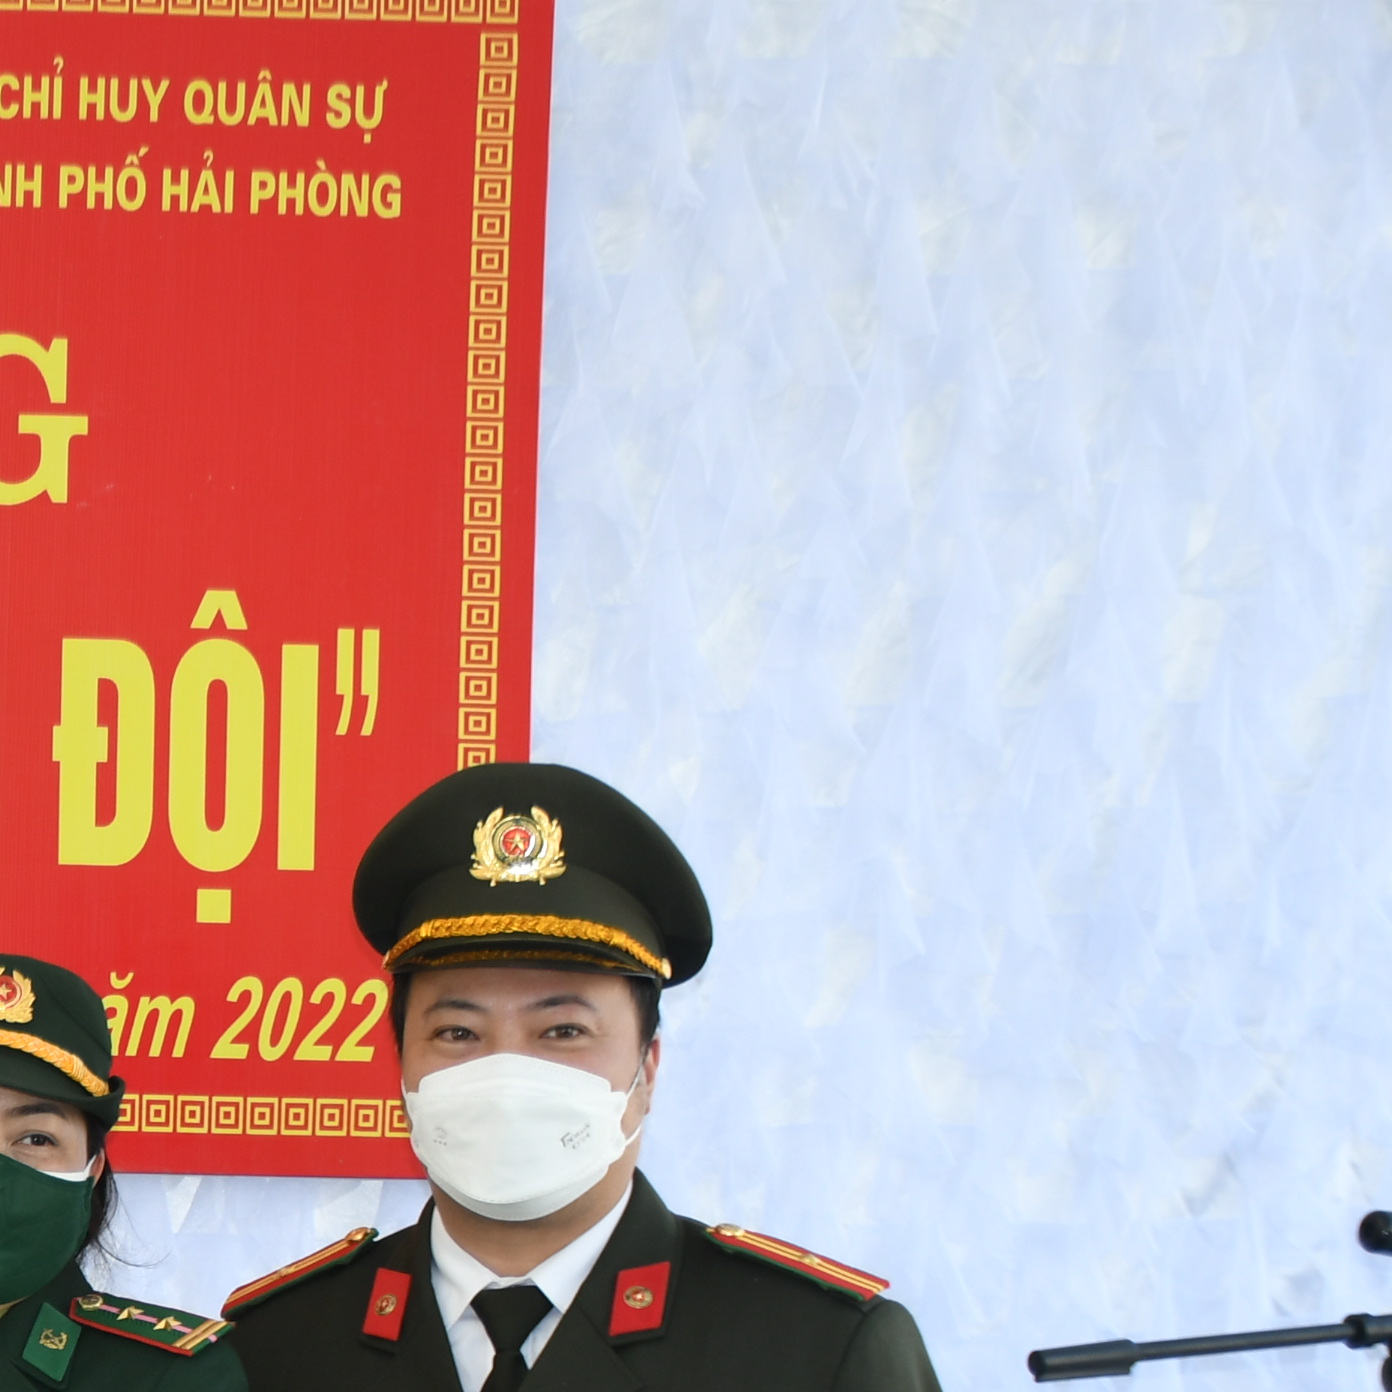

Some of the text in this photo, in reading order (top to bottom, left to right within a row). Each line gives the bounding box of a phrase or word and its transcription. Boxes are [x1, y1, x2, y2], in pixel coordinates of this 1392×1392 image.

[79, 77, 169, 123] HUY
[184, 70, 310, 128] QUÂN
[326, 80, 387, 142] SỰ
[59, 147, 148, 212] PHỐ
[162, 151, 234, 214] HẢI
[251, 161, 402, 219] PHÒNG
[210, 976, 389, 1063] 2022
